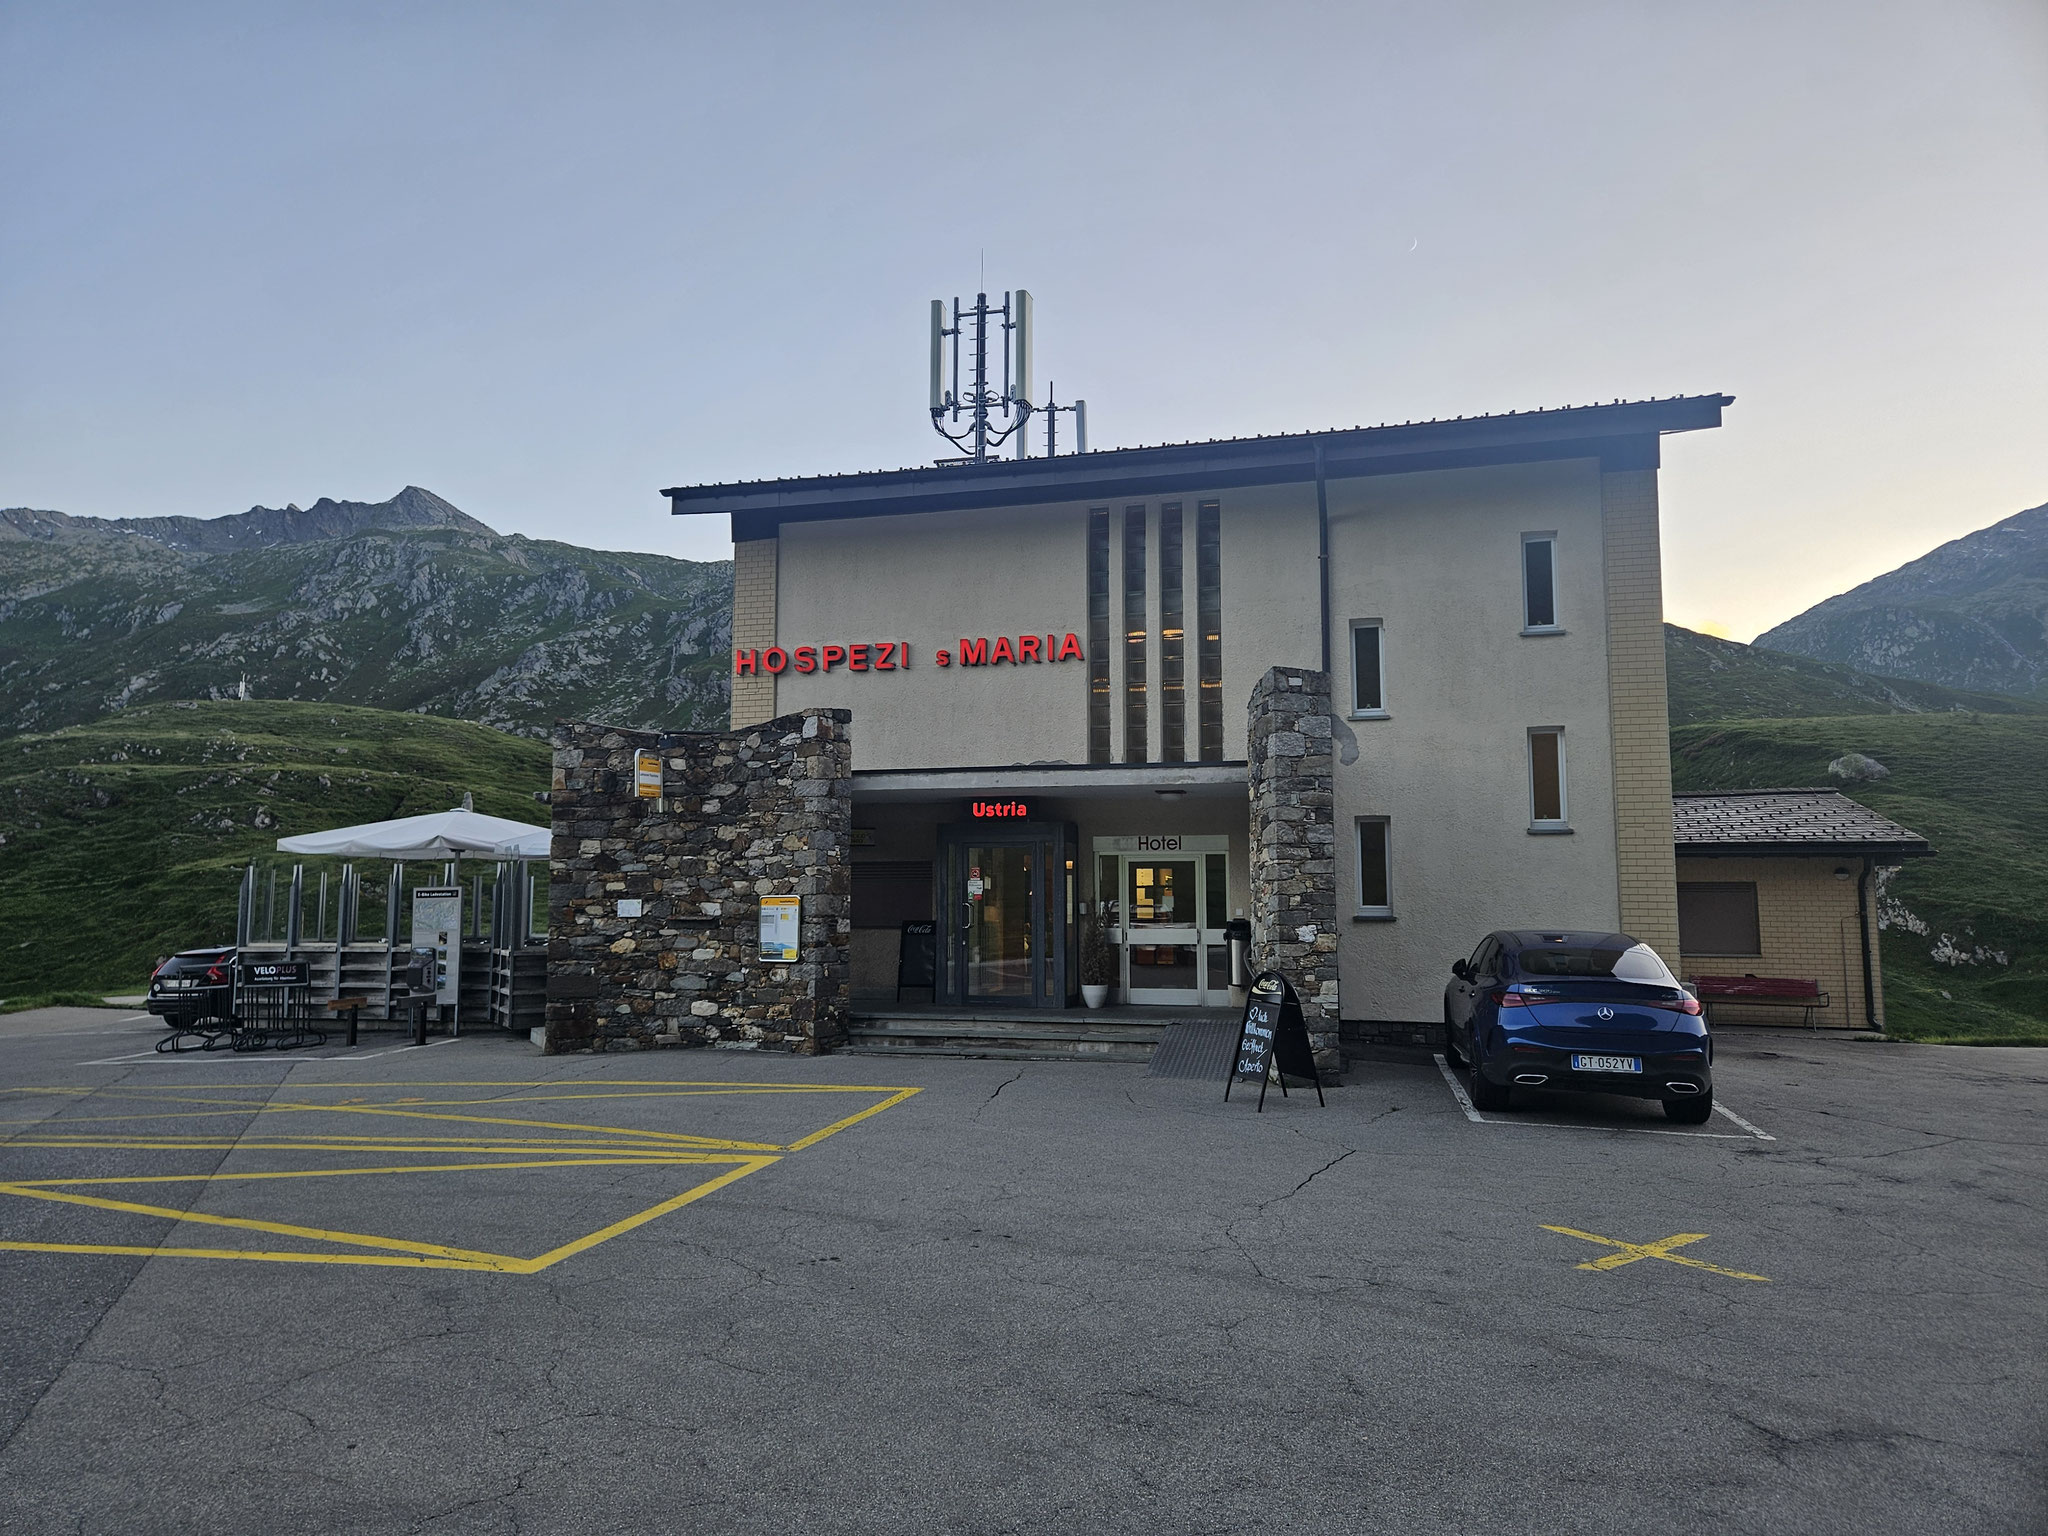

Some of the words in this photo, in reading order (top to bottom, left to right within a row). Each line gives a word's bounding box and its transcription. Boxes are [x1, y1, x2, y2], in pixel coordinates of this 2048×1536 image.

[736, 642, 910, 675] HOSPEZI
[959, 633, 1084, 667] MARIA
[973, 801, 1027, 817] Ustria
[1138, 836, 1182, 851] Hotel
